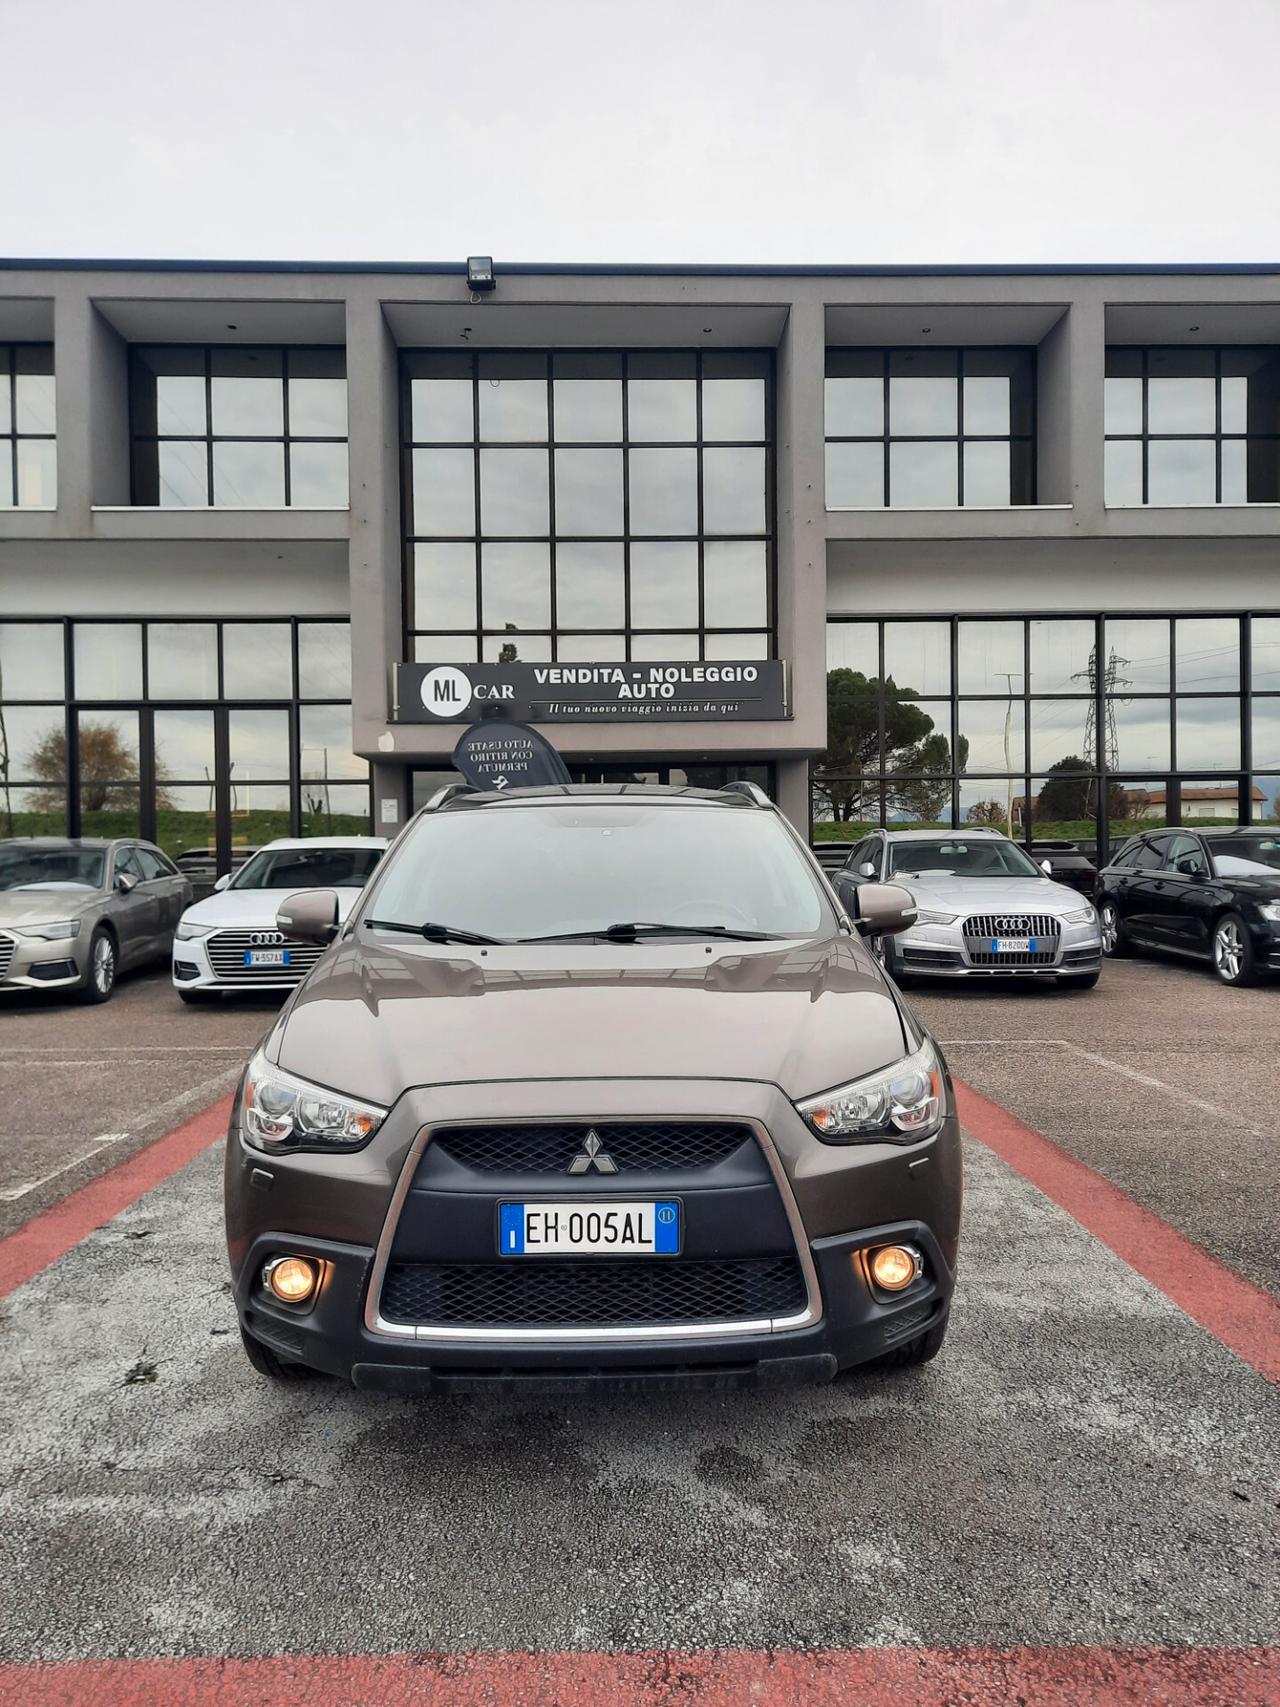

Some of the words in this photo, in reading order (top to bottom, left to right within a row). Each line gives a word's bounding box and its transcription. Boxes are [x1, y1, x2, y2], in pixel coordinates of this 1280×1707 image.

[533, 668, 626, 684] VENDITA
[649, 666, 758, 683] NOLEGGIO
[433, 679, 462, 702] ML
[473, 684, 516, 700] CAR
[617, 683, 675, 699] AUTO
[549, 703, 559, 713] Il
[562, 704, 581, 713] tuo
[584, 704, 618, 713] nuovo
[621, 703, 662, 715] viaggio
[666, 702, 699, 712] inizia
[703, 701, 717, 712] da
